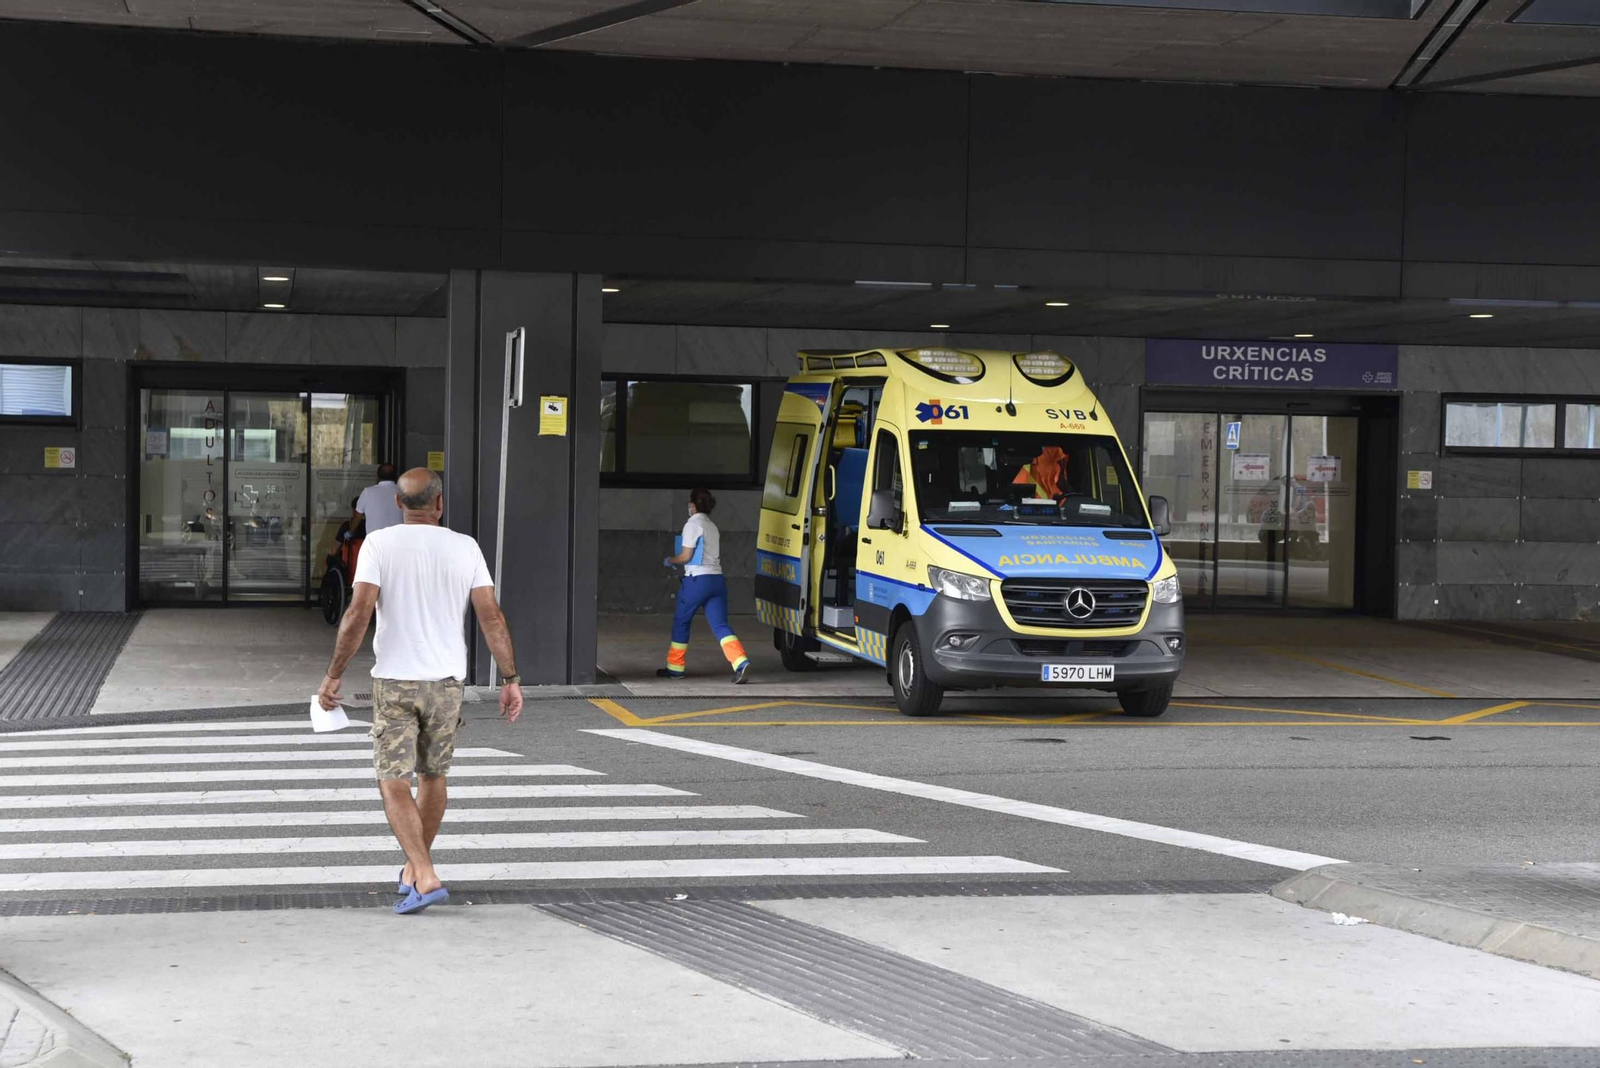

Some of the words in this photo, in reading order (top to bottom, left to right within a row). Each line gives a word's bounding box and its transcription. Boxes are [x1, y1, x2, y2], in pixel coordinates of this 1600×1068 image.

[1202, 345, 1327, 363] URXENCIAS
[1213, 363, 1314, 382] CRÍTICAS
[930, 404, 970, 420] 061
[1045, 408, 1087, 420] SVB
[1060, 422, 1086, 430] A-669
[203, 400, 216, 520] ADULTOS
[875, 550, 885, 566] 061
[1052, 667, 1085, 679] 5970
[1088, 667, 1112, 680] LHM
